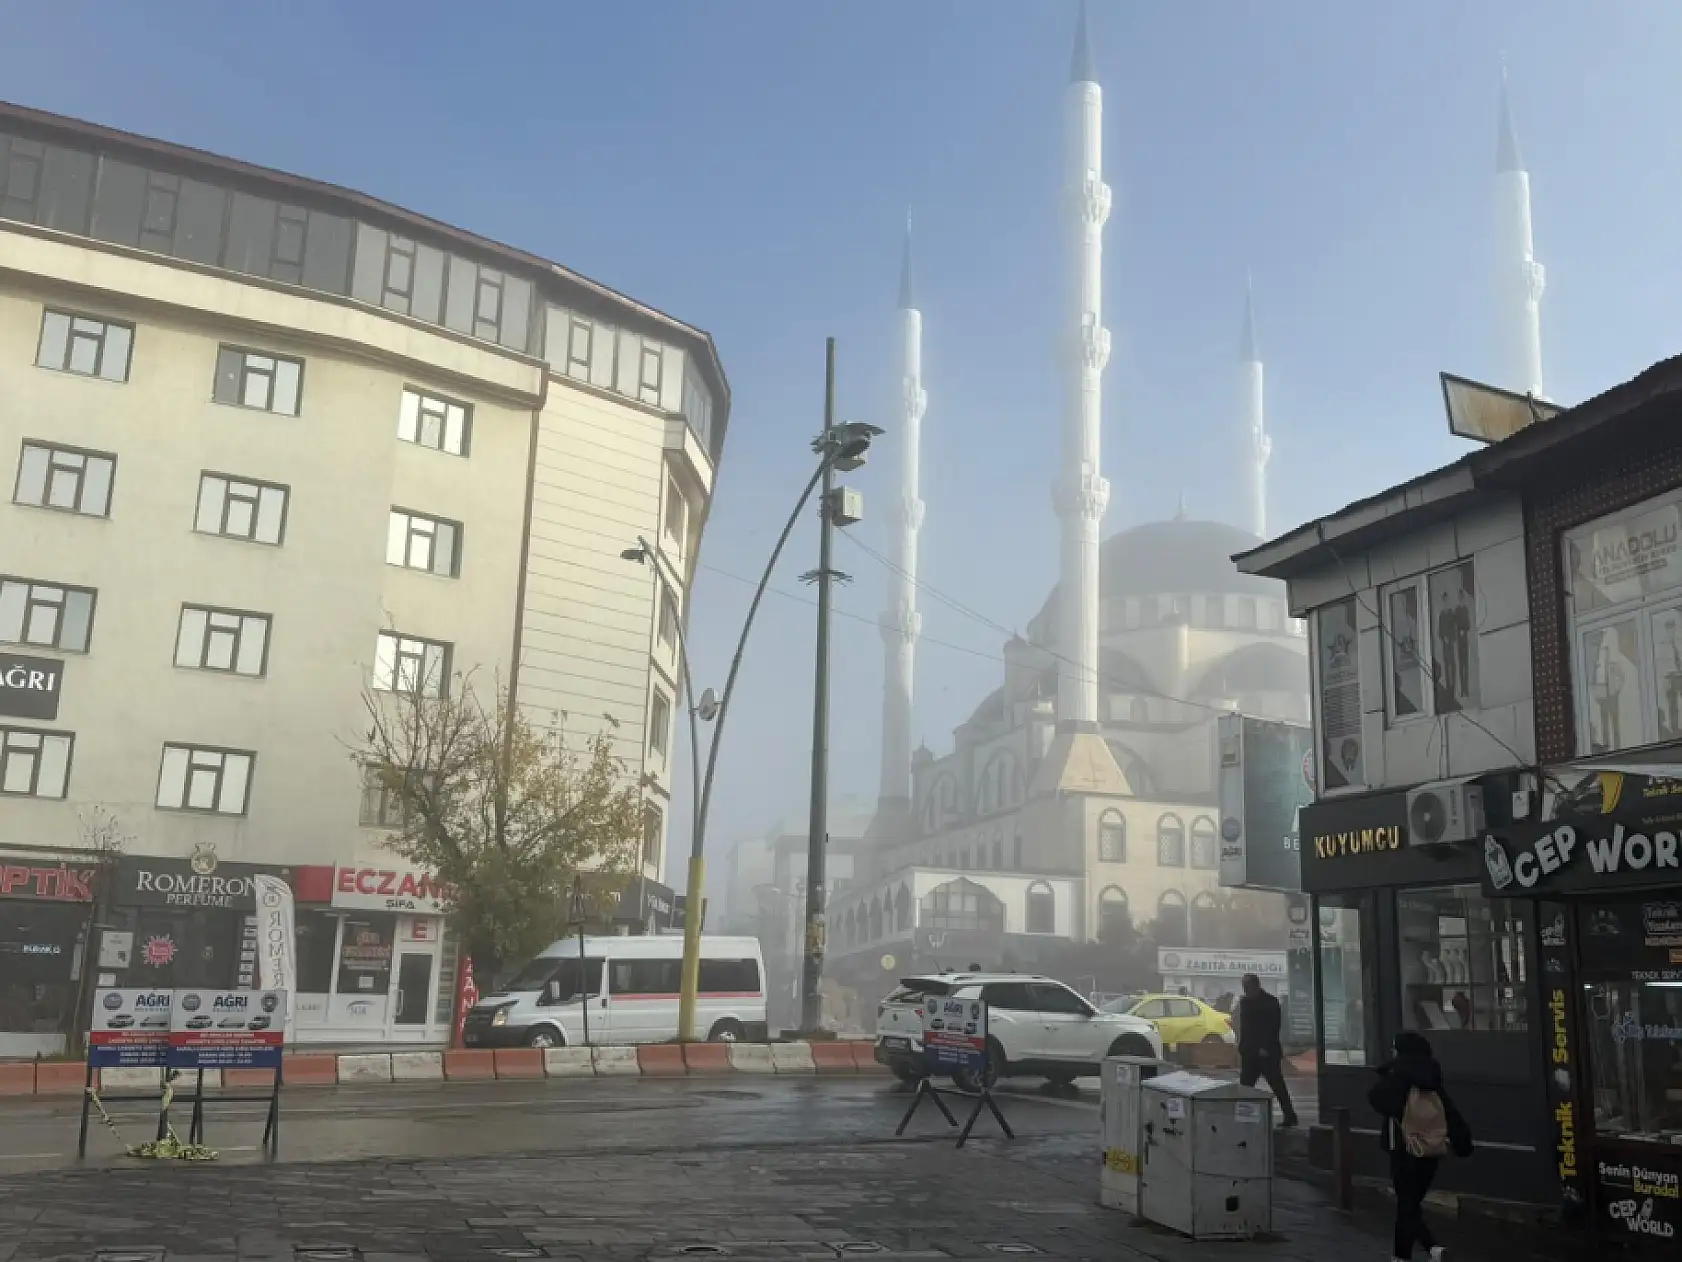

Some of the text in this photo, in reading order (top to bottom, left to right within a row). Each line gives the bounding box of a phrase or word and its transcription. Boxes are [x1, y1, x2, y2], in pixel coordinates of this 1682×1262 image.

[0, 663, 56, 692] ĞRI
[1313, 825, 1400, 859] KUYUMCU
[1514, 823, 1682, 888] CEP WOR
[0, 862, 96, 899] PTİK
[165, 893, 234, 908] PERFUME
[135, 991, 170, 1007] AĞRI
[212, 993, 249, 1007] AĞRI
[1548, 988, 1569, 1064] Servis
[1553, 1101, 1578, 1180] Teknik
[1608, 1199, 1637, 1219] CEP
[1626, 1211, 1674, 1238] WORLD
